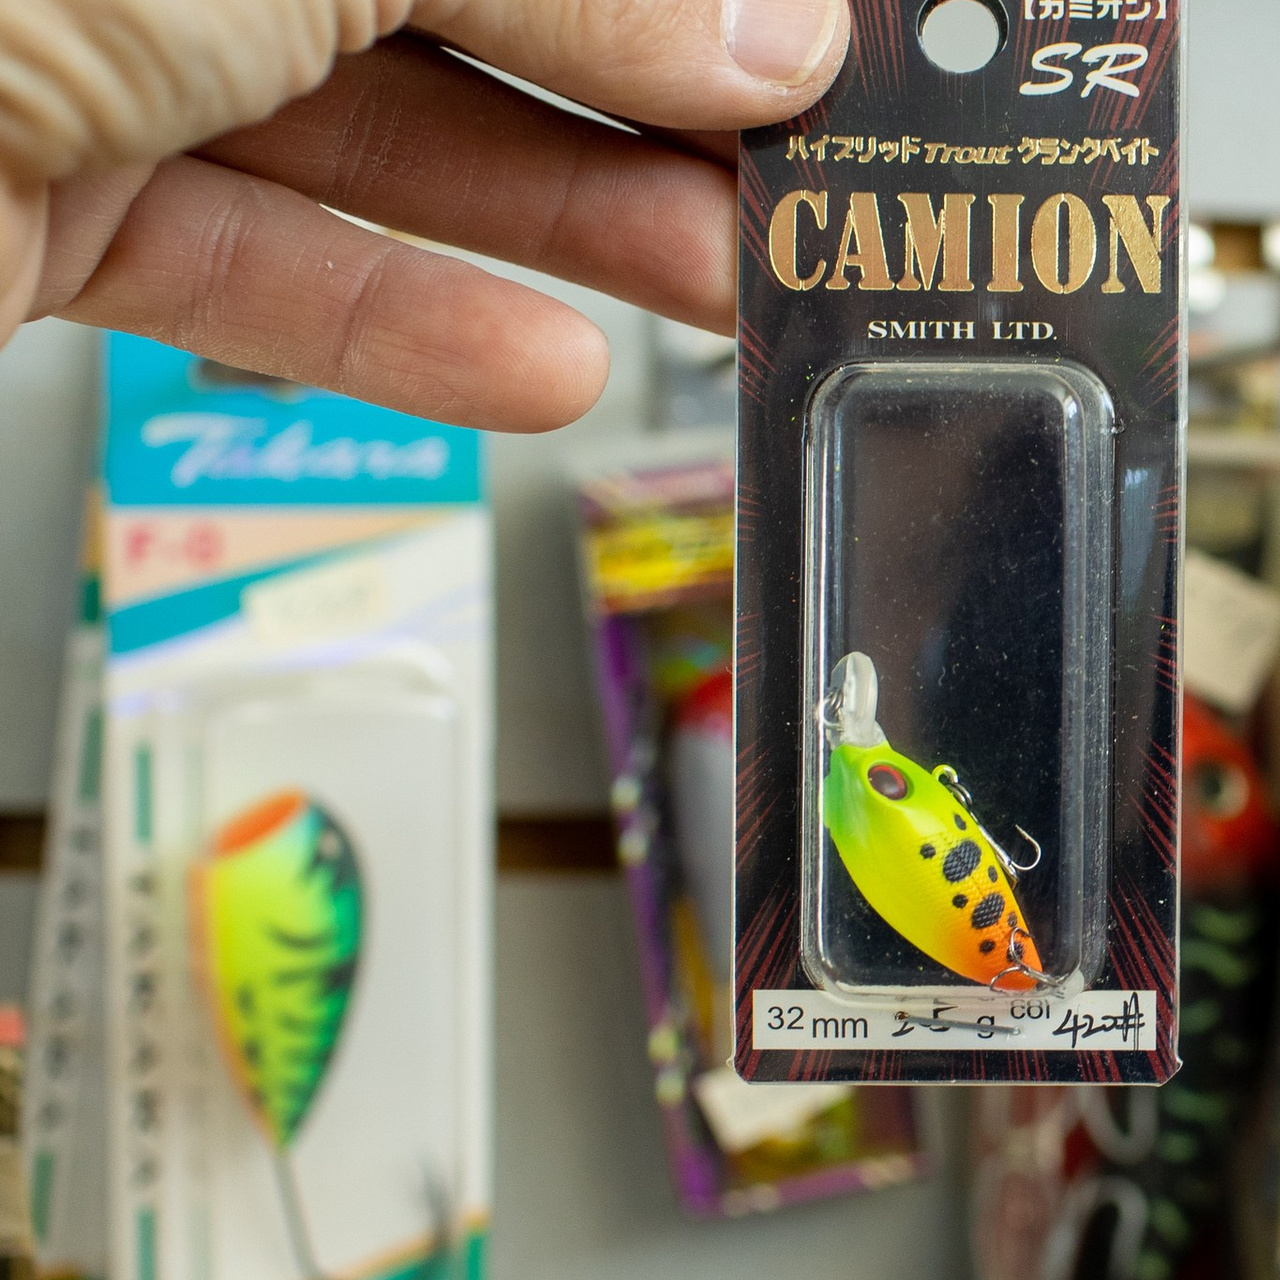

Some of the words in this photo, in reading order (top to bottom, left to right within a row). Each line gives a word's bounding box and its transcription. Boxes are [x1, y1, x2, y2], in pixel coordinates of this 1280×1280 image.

[1019, 42, 1149, 98] SR
[768, 189, 1171, 295] CAMION
[867, 320, 976, 341] SMITH
[992, 322, 1057, 341] LTD.
[767, 1006, 804, 1030] 32
[812, 1015, 868, 1038] mm
